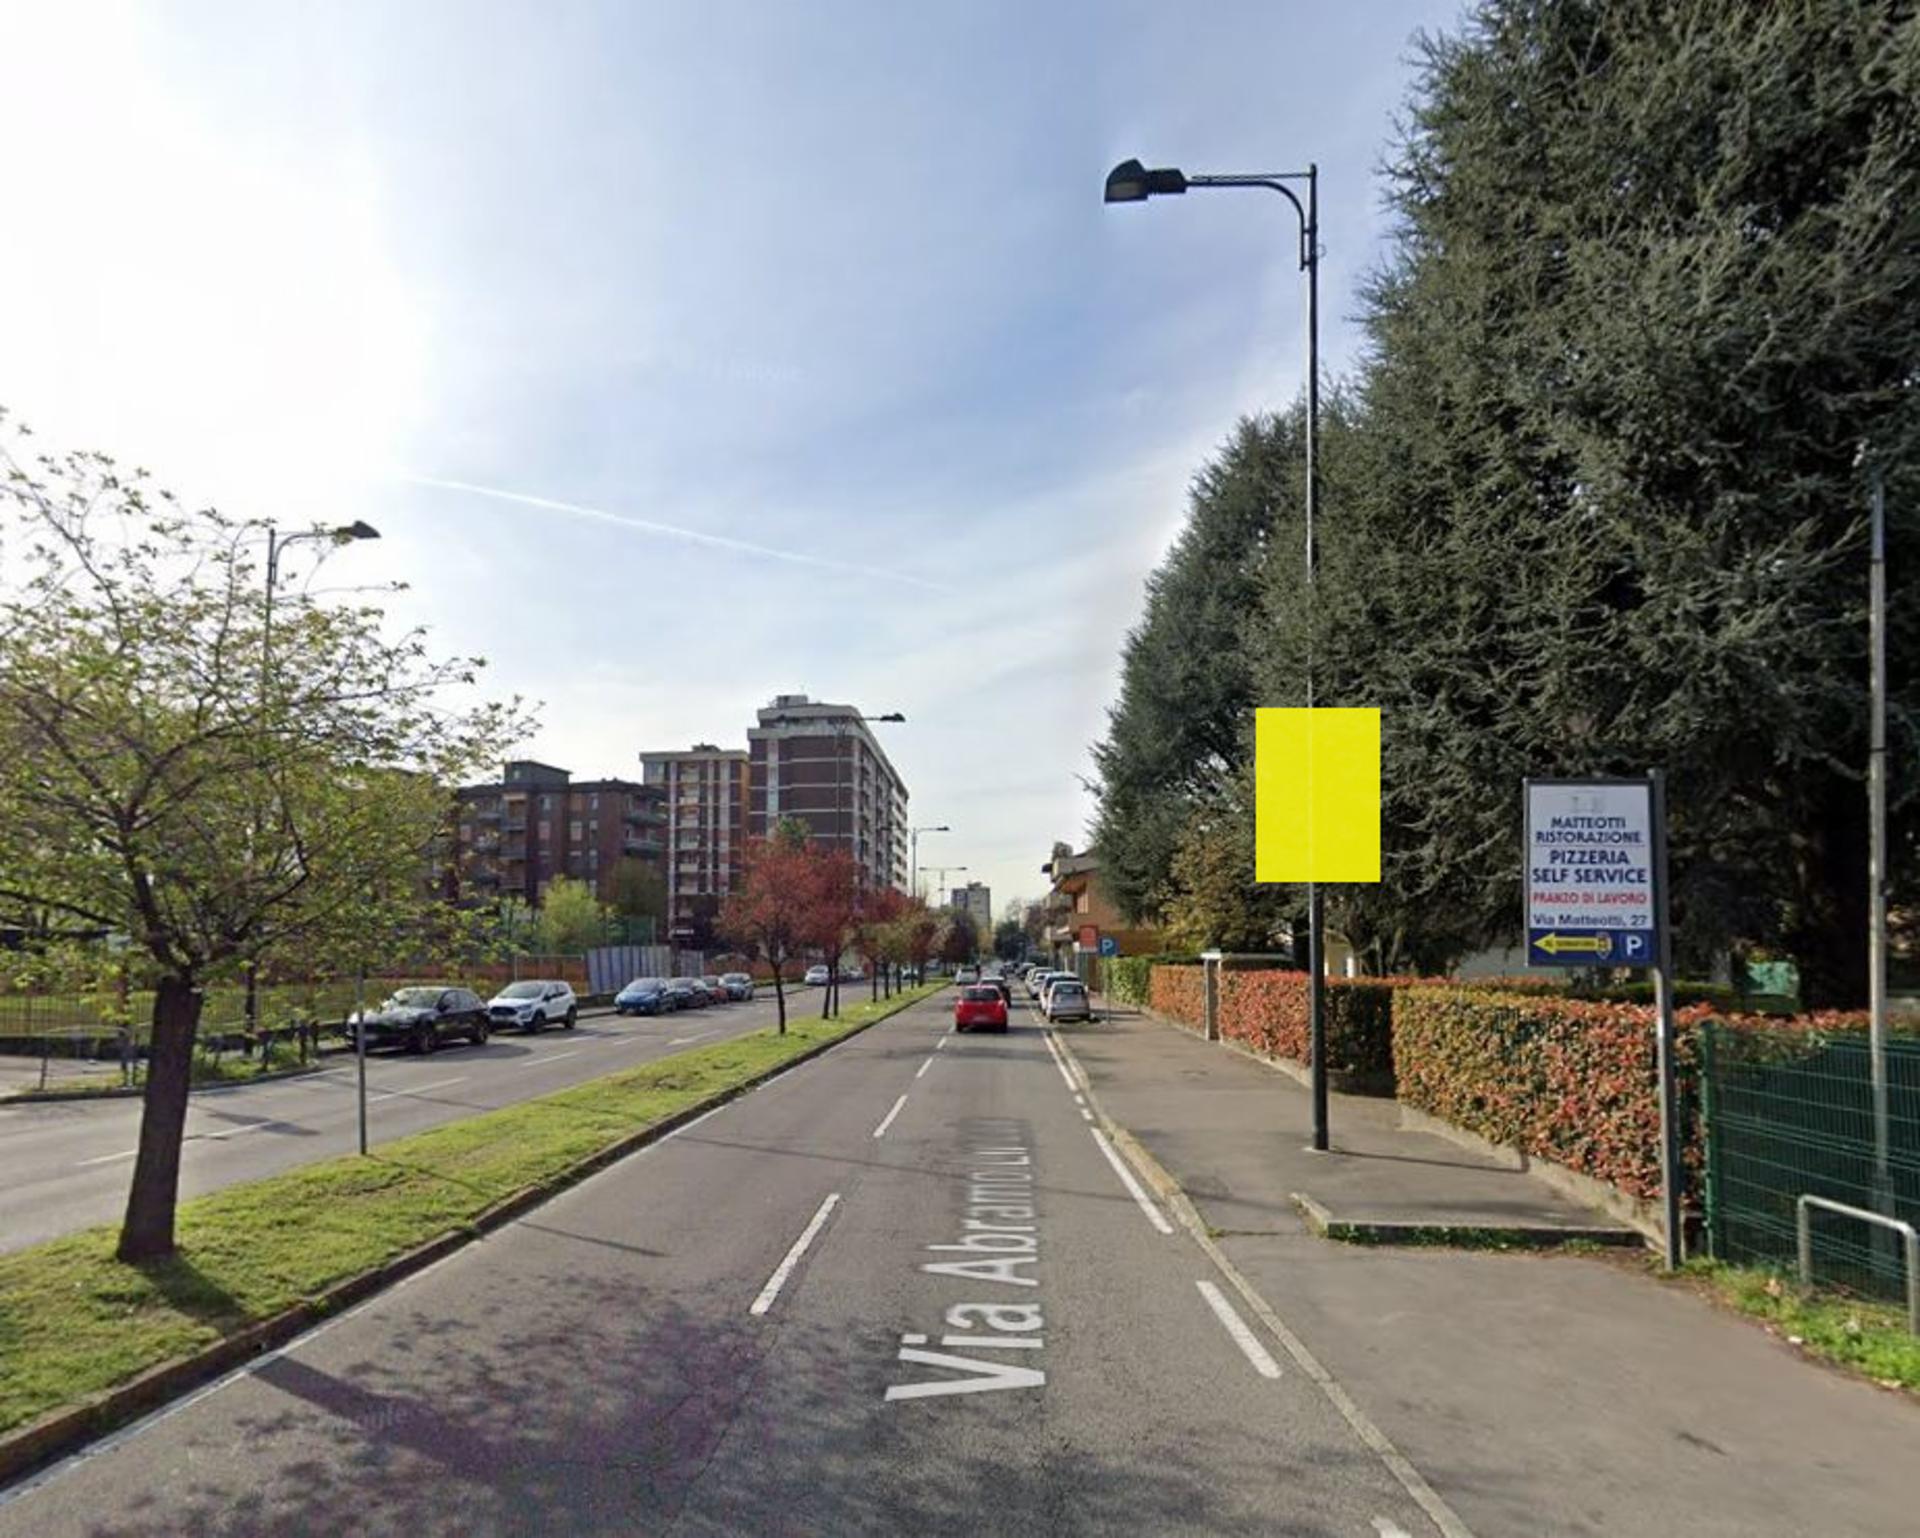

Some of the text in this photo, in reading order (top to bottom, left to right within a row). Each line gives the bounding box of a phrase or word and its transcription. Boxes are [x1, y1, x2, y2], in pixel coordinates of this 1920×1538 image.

[1551, 816, 1626, 829] MATTEOTTI
[1536, 831, 1642, 844] RISTORAZIONE
[1550, 850, 1630, 865] PIZZERIA
[1532, 868, 1648, 884] SELF SERVICE
[1532, 891, 1648, 904] PRANZO DI LAVORO
[1533, 914, 1555, 927] Via
